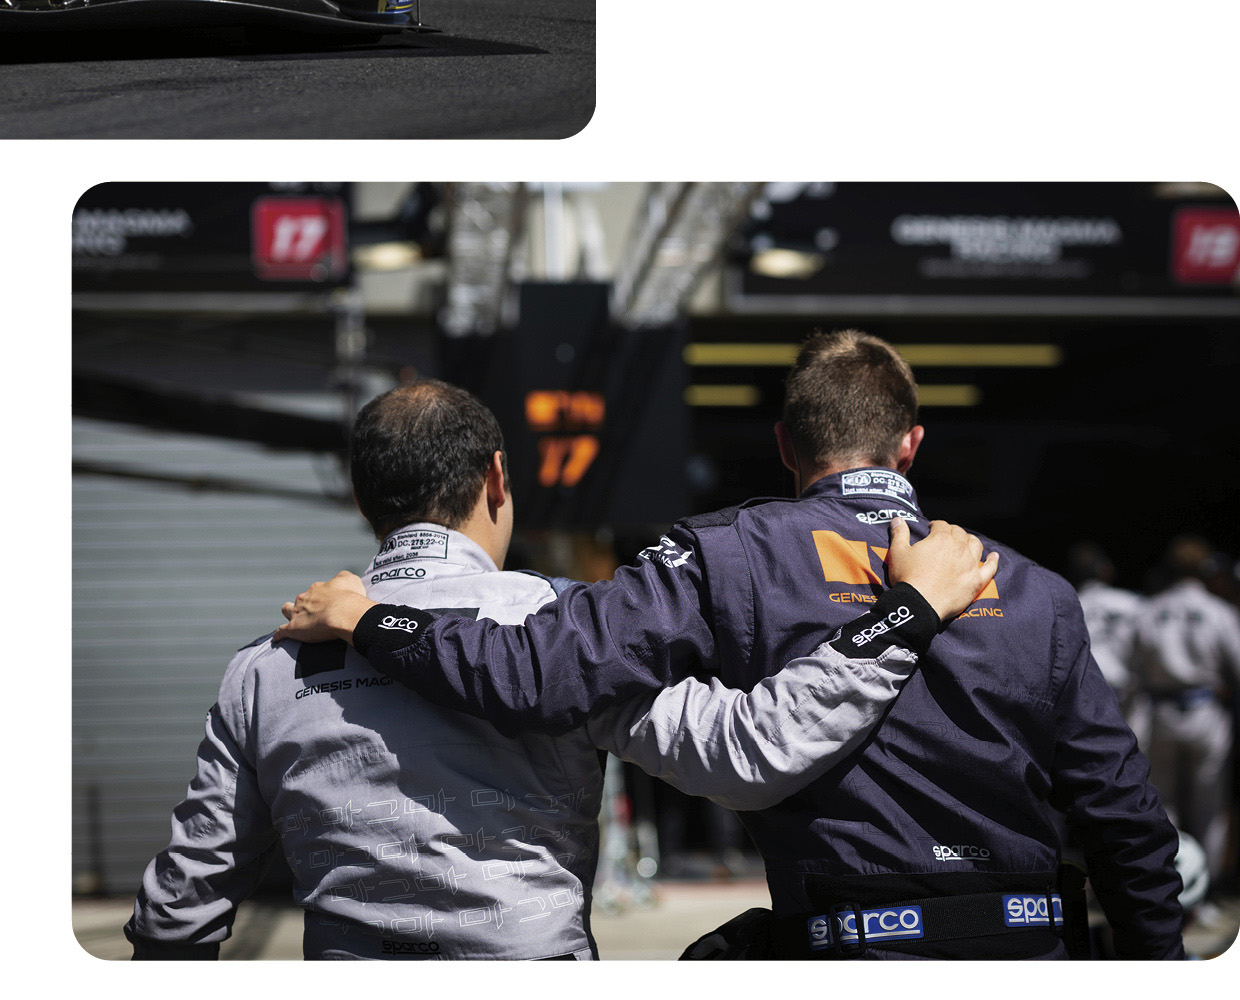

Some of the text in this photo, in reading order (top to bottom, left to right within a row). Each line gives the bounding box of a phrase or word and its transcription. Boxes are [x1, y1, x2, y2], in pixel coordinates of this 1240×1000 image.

[269, 213, 330, 263] 17
[371, 567, 427, 585] sparco
[829, 592, 1004, 621] GENES ACING
[378, 615, 419, 633] arco
[852, 606, 914, 647] sparco
[295, 677, 393, 700] GENESIS MAG
[933, 845, 990, 862] sparco
[1007, 897, 1064, 924] spa
[811, 908, 921, 946] sarco
[382, 940, 442, 955] sparco
